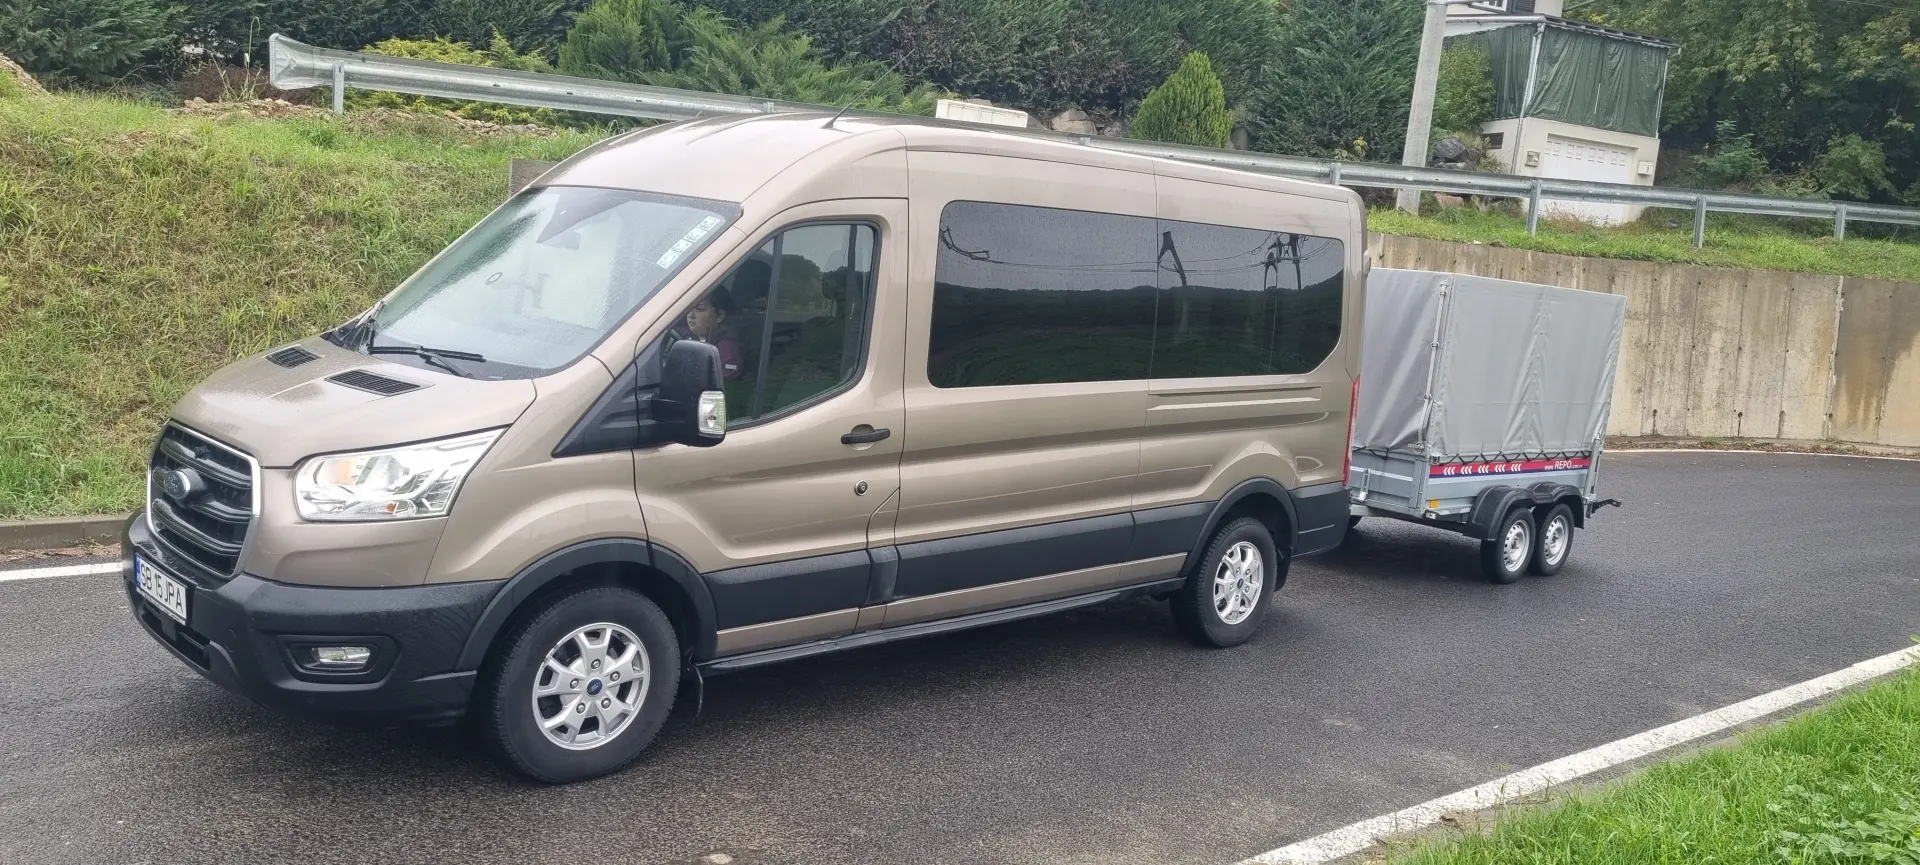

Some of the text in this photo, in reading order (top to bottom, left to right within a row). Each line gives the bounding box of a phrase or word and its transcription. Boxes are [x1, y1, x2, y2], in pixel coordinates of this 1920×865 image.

[140, 563, 184, 614] SB 15 JPA
